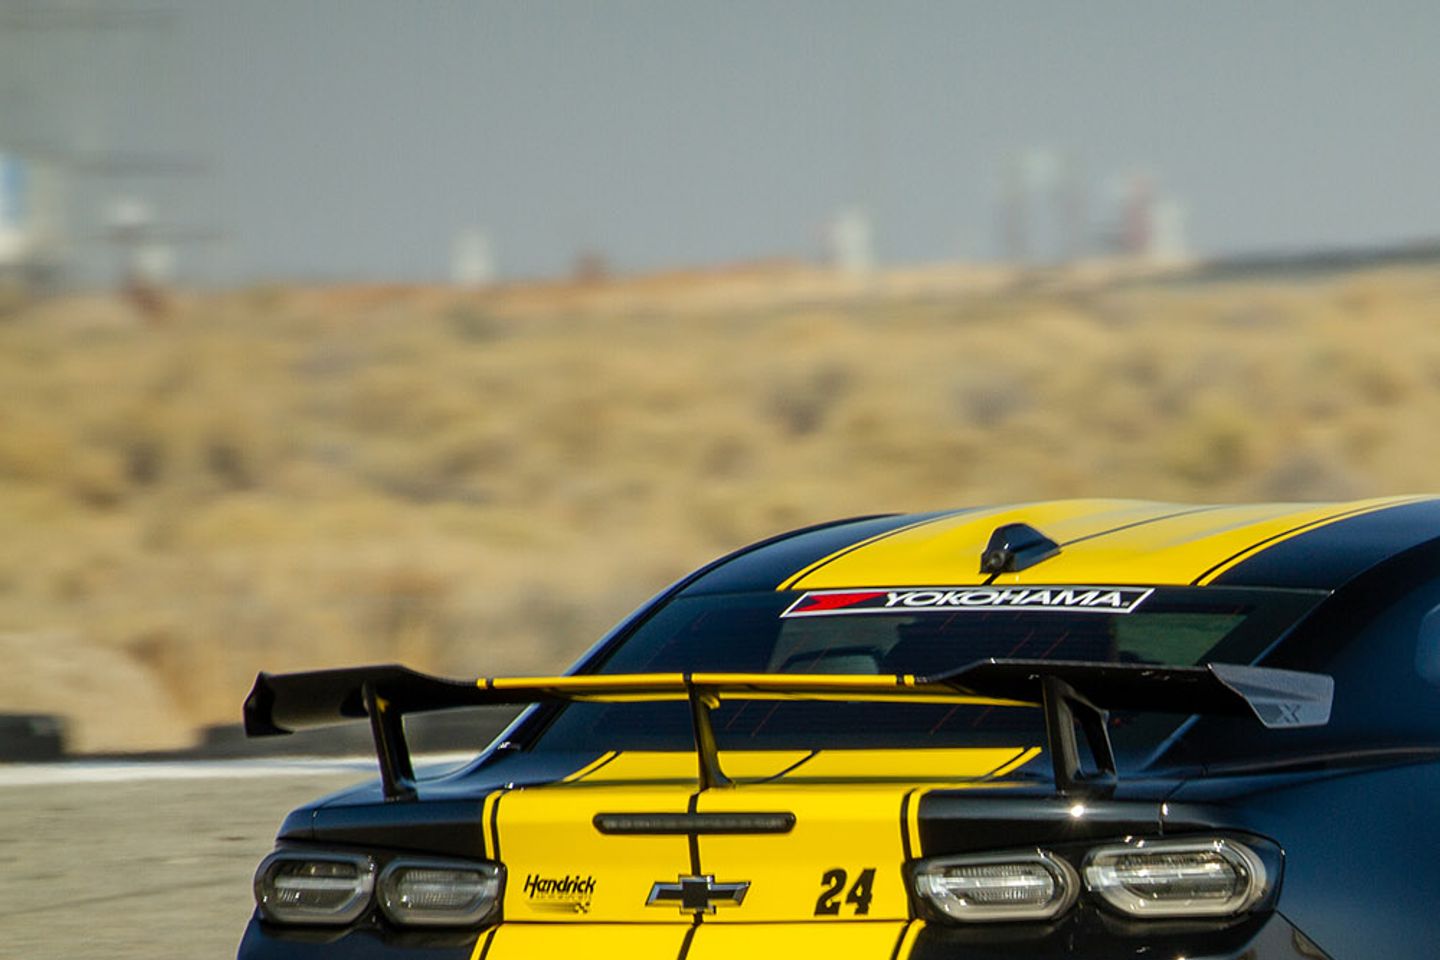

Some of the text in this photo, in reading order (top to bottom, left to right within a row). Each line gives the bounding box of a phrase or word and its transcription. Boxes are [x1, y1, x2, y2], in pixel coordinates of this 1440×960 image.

[884, 590, 1129, 607] YOKOHAMA
[523, 874, 596, 898] Hendrick
[814, 868, 877, 916] 24
